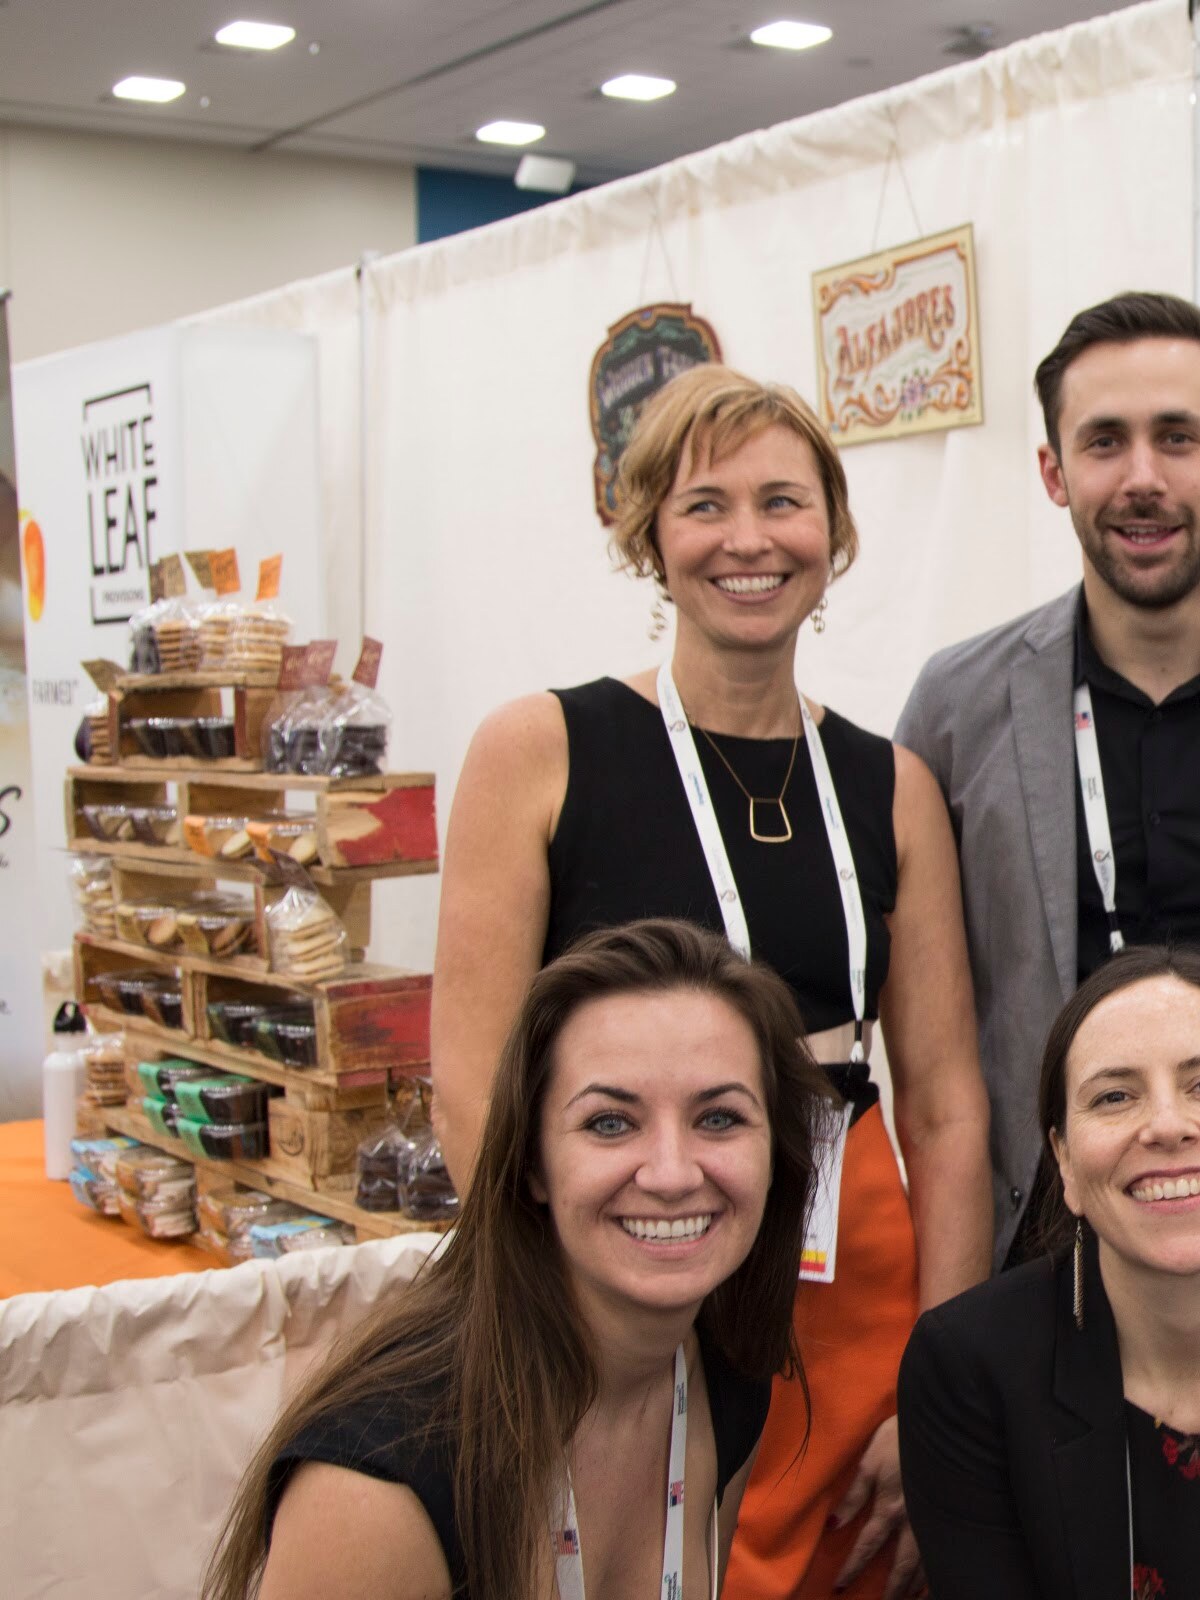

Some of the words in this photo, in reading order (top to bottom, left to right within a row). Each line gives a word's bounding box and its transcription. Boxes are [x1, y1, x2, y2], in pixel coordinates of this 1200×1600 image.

[834, 285, 956, 389] ALFAJORES
[81, 415, 154, 480] WHITE
[87, 477, 157, 577] LEAF
